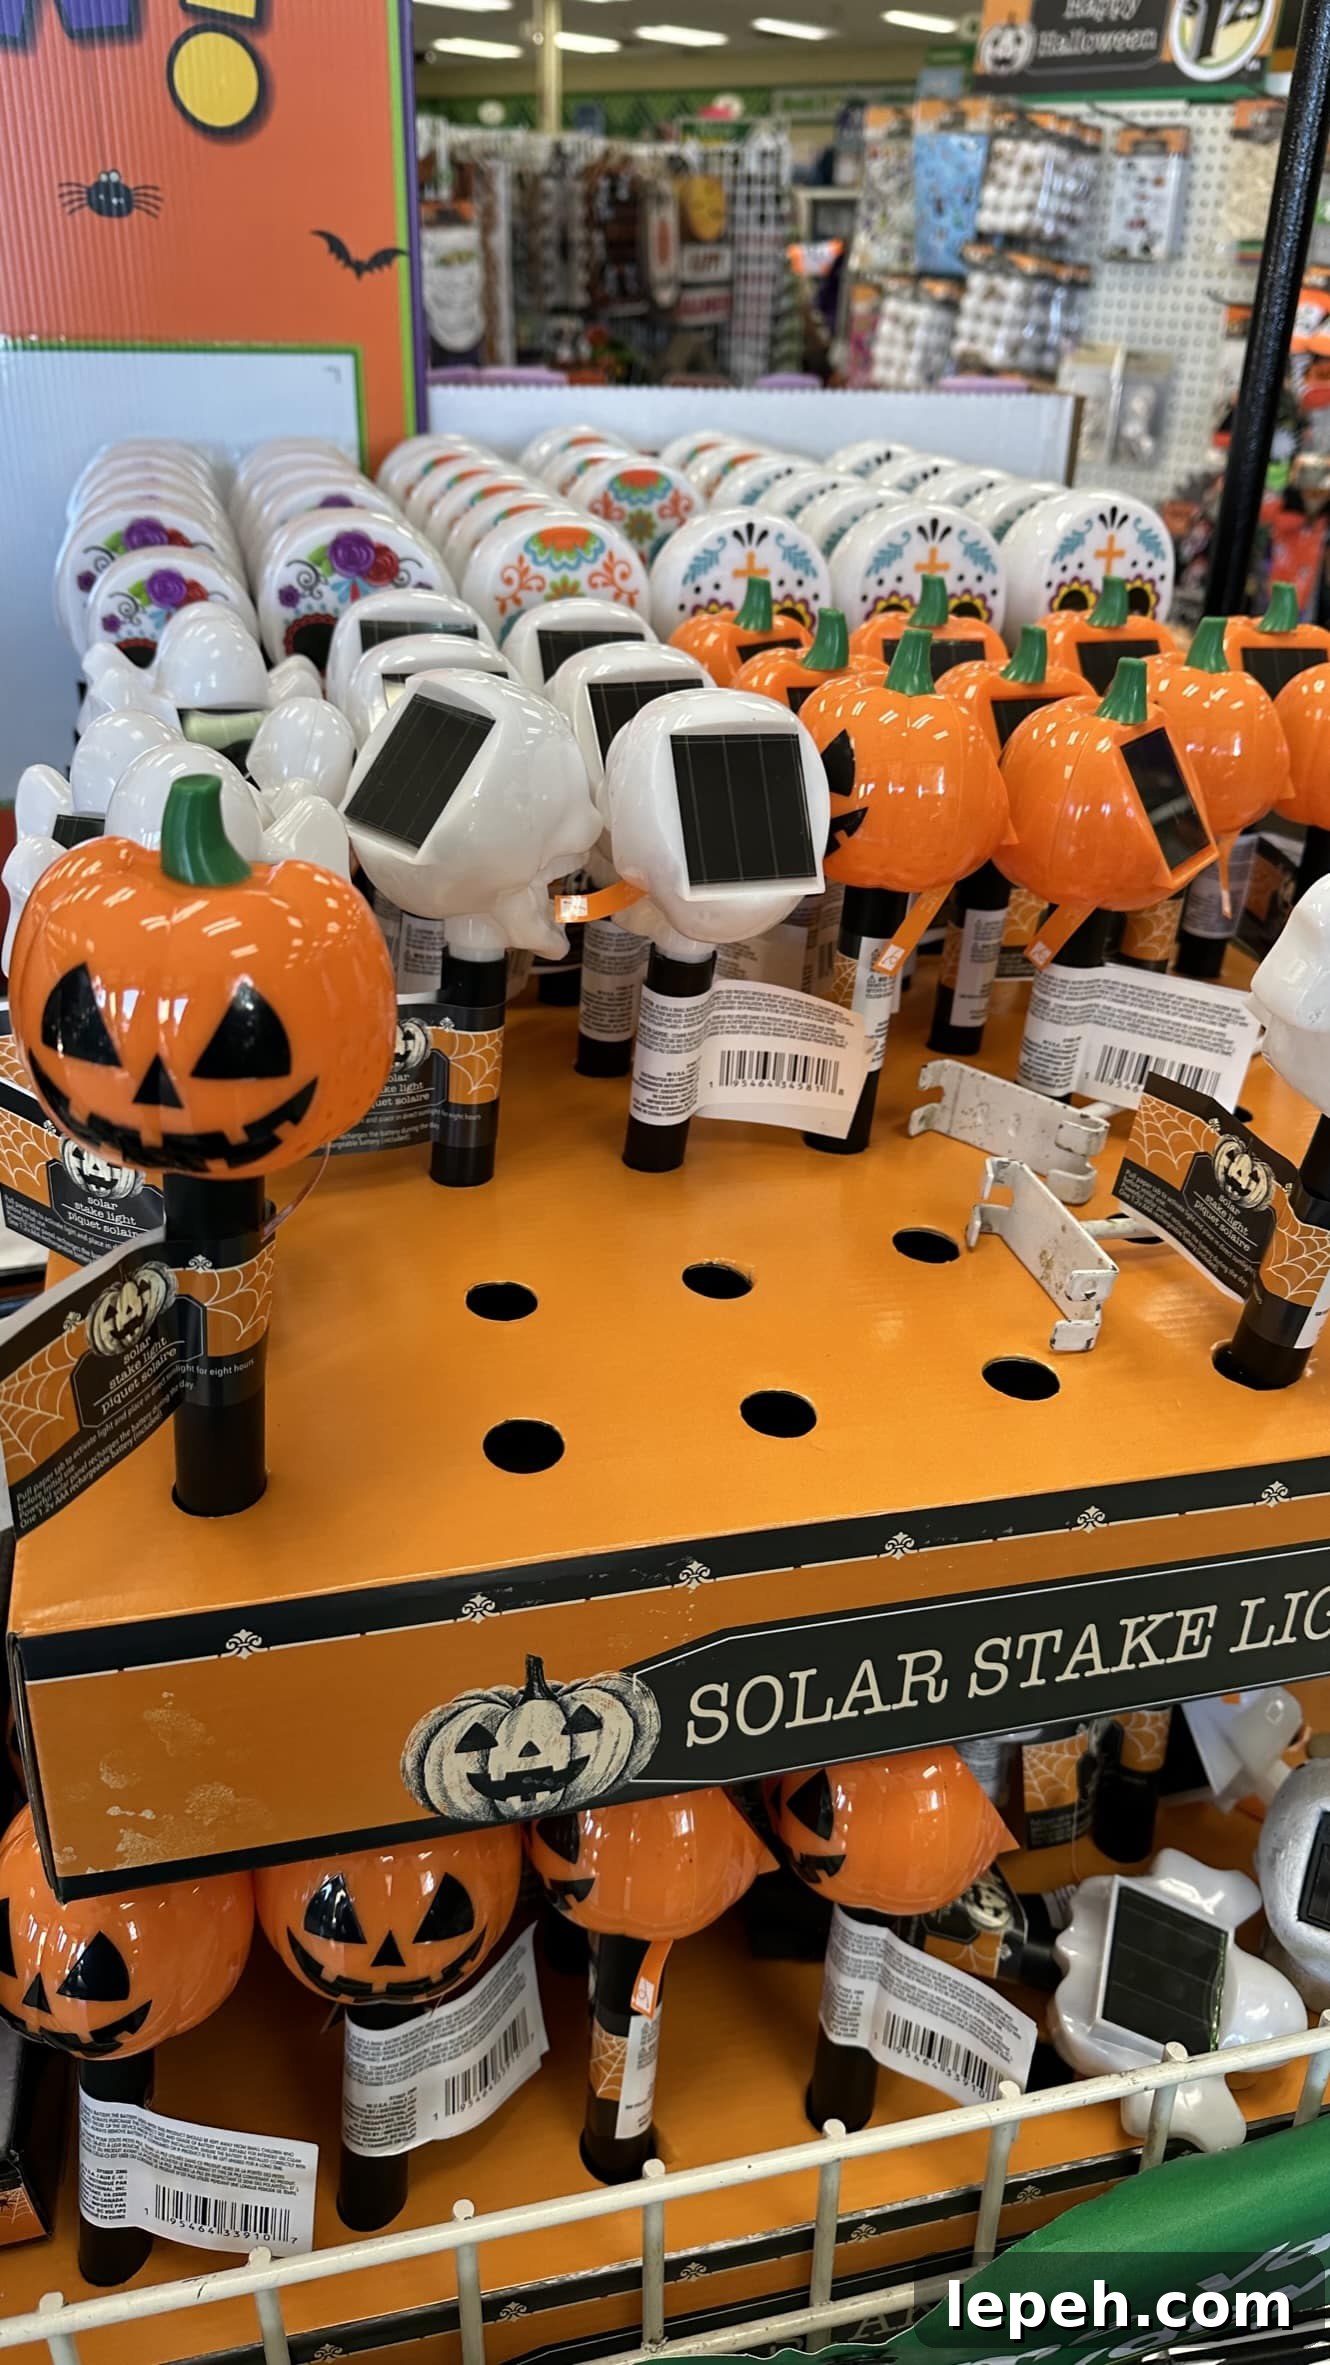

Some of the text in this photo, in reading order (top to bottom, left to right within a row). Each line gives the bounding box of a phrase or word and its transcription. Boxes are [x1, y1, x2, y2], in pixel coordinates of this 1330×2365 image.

[1038, 27, 1157, 56] Halloween
[388, 1073, 410, 1082] olar
[399, 1082, 424, 1094] light
[395, 1093, 430, 1105] solaire
[74, 1202, 136, 1226] stake light
[87, 1196, 118, 1211] solar
[1204, 1194, 1250, 1237] stake light
[1218, 1194, 1241, 1216] solar
[67, 1211, 138, 1238] piquet solair
[1193, 1199, 1251, 1252] piquet solaire
[109, 1337, 168, 1389] stake light
[123, 1336, 151, 1364] solar
[101, 1347, 177, 1414] piquet solaire
[196, 1366, 208, 1376] for
[209, 1365, 232, 1378] eight
[233, 1358, 255, 1372] hours
[685, 1648, 949, 1748] SOLAR
[967, 1603, 1218, 1700] STAKE
[170, 2217, 215, 2235] 95464
[223, 2229, 272, 2242] 33910
[290, 2236, 298, 2246] 7
